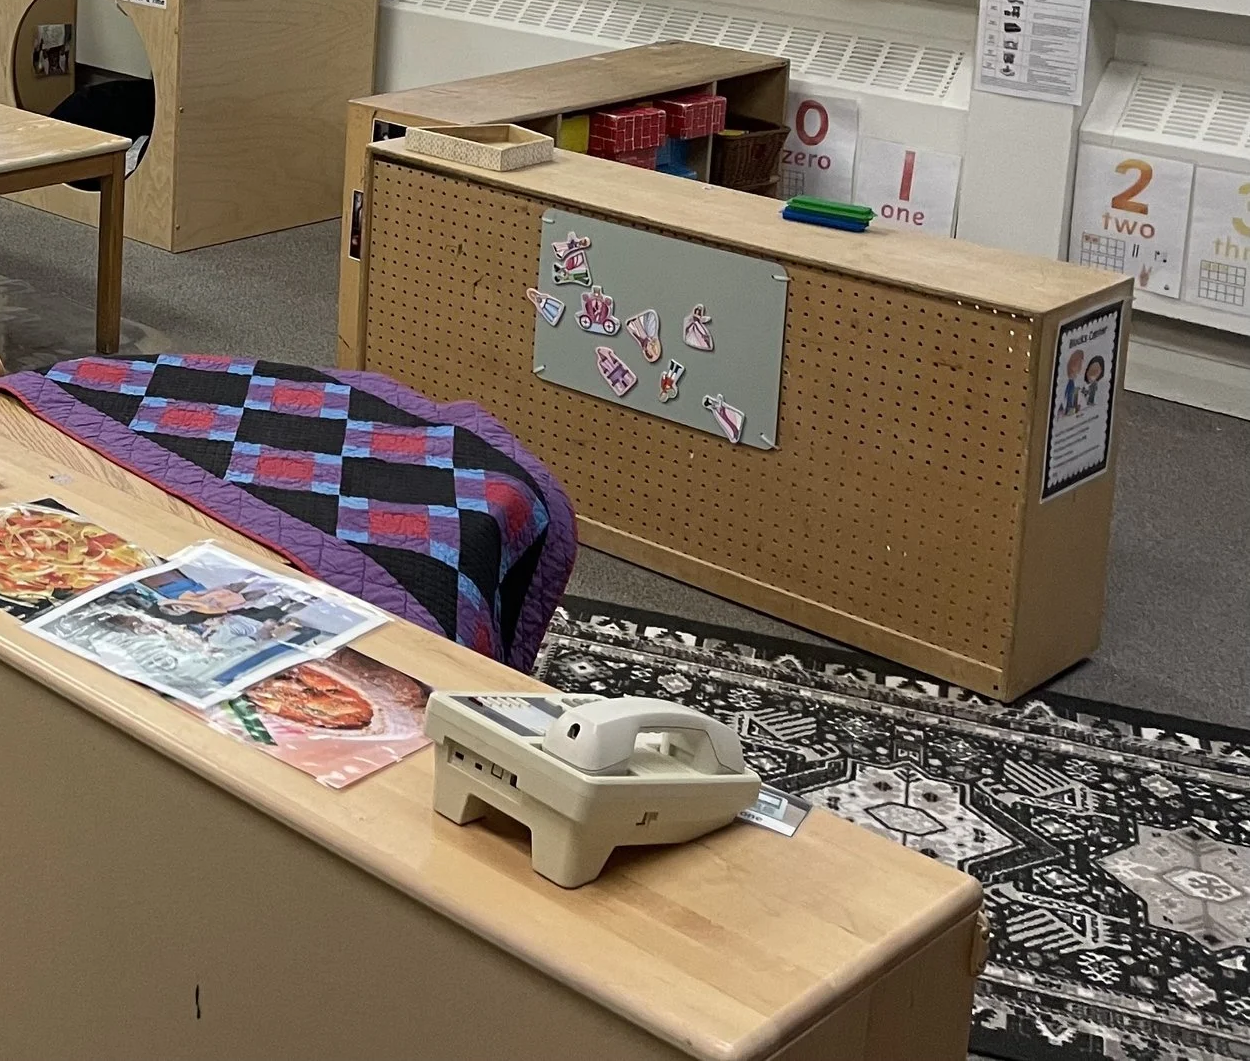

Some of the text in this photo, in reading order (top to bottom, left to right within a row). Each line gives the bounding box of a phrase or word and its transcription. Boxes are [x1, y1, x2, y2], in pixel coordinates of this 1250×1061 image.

[796, 100, 829, 146] 0
[782, 149, 831, 170] zero
[1111, 158, 1153, 215] 2
[881, 204, 925, 226] one
[1102, 212, 1156, 239] two
[739, 810, 764, 822] one
